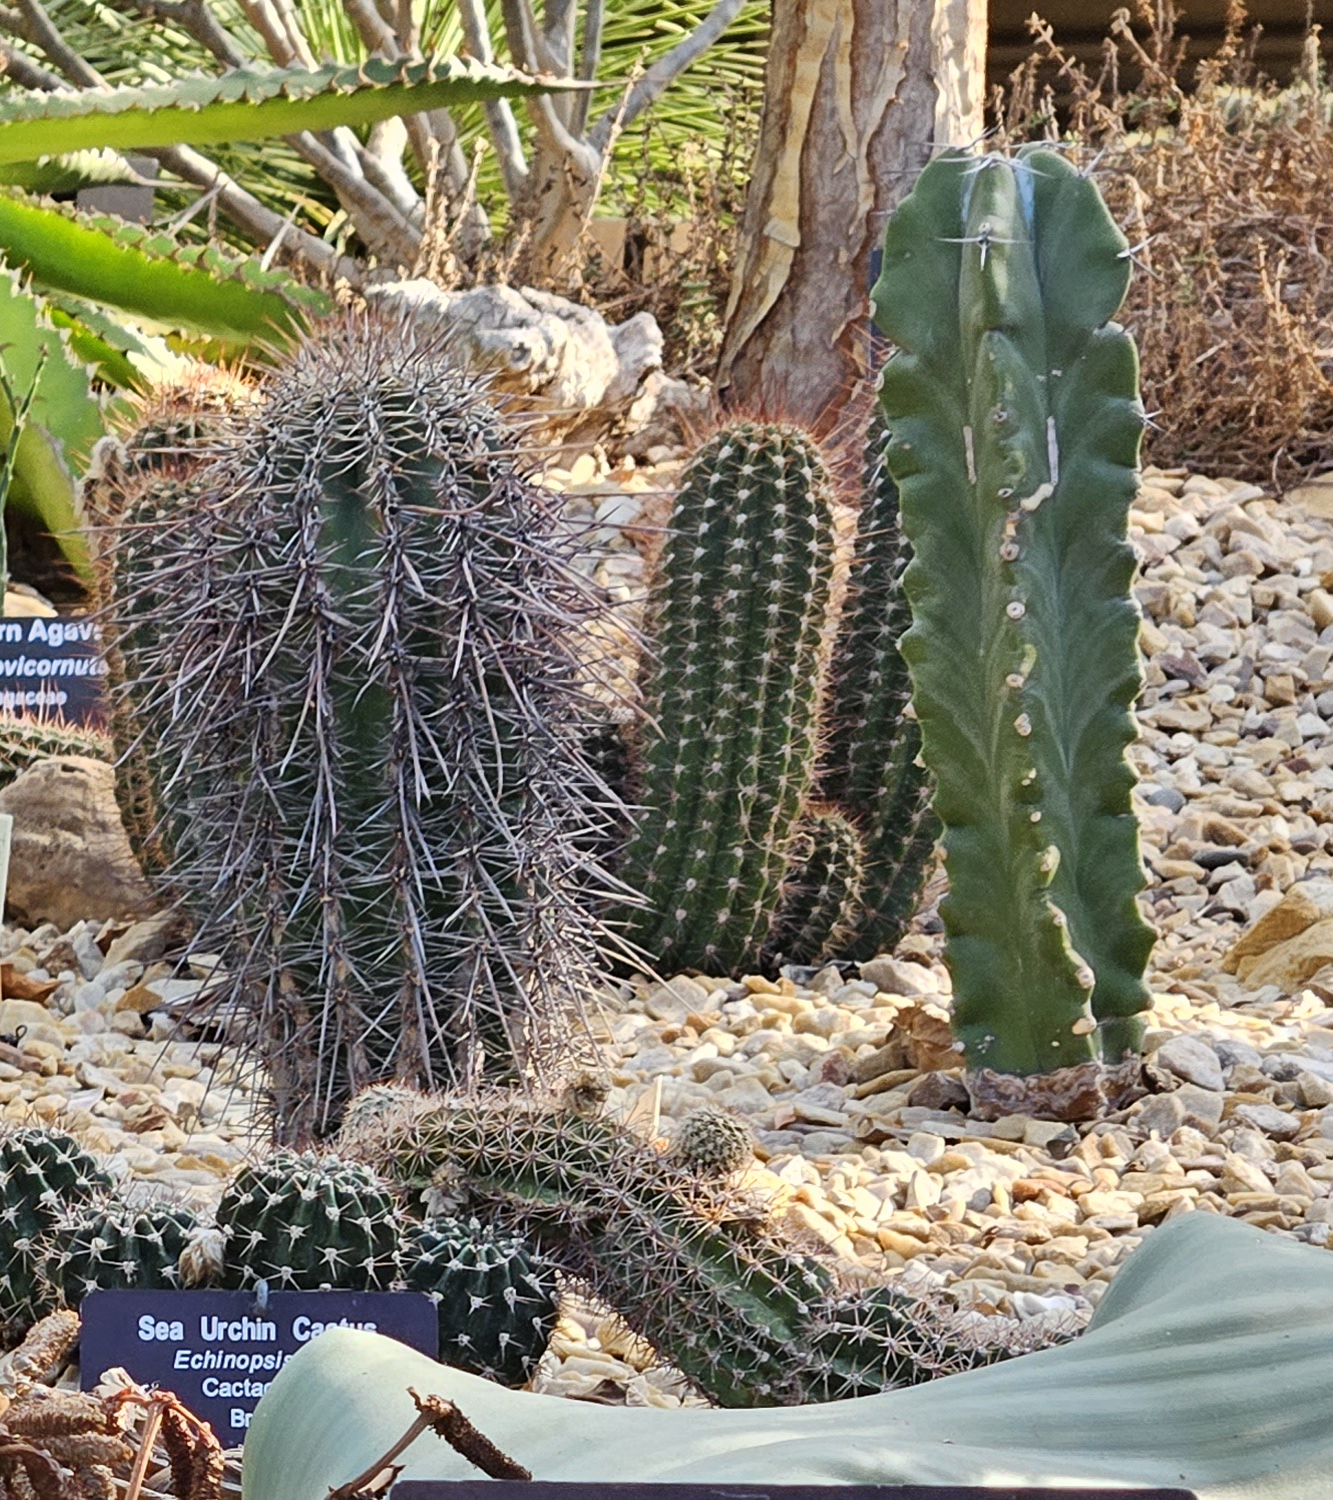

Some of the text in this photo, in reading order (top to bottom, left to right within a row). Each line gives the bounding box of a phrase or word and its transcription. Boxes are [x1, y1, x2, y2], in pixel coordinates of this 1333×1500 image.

[138, 1315, 184, 1341] Sea
[200, 1316, 276, 1341] Urchin
[202, 1377, 271, 1398] Cacta
